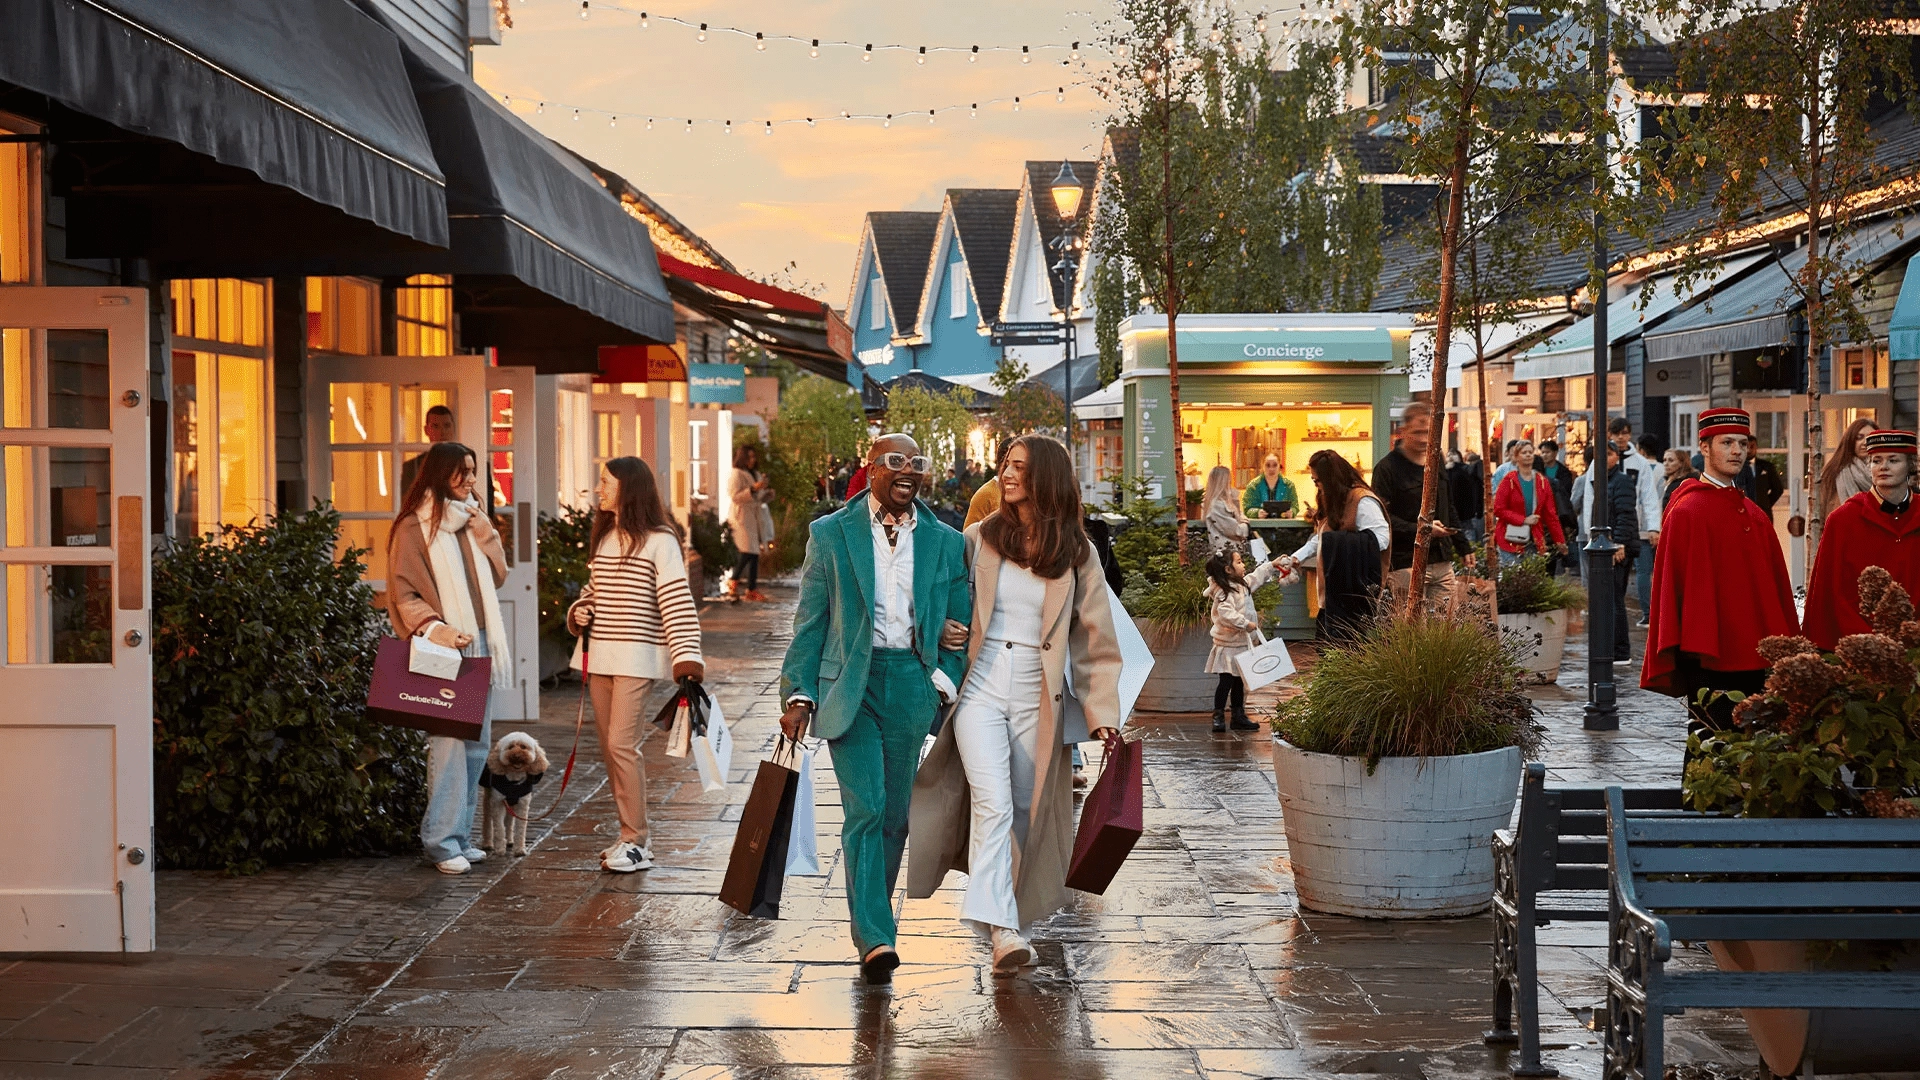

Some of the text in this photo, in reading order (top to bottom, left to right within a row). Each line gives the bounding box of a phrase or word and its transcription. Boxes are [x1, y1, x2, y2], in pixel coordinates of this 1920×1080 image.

[1243, 343, 1324, 360] Concierge
[690, 376, 714, 386] David
[399, 692, 431, 704] Charlotte
